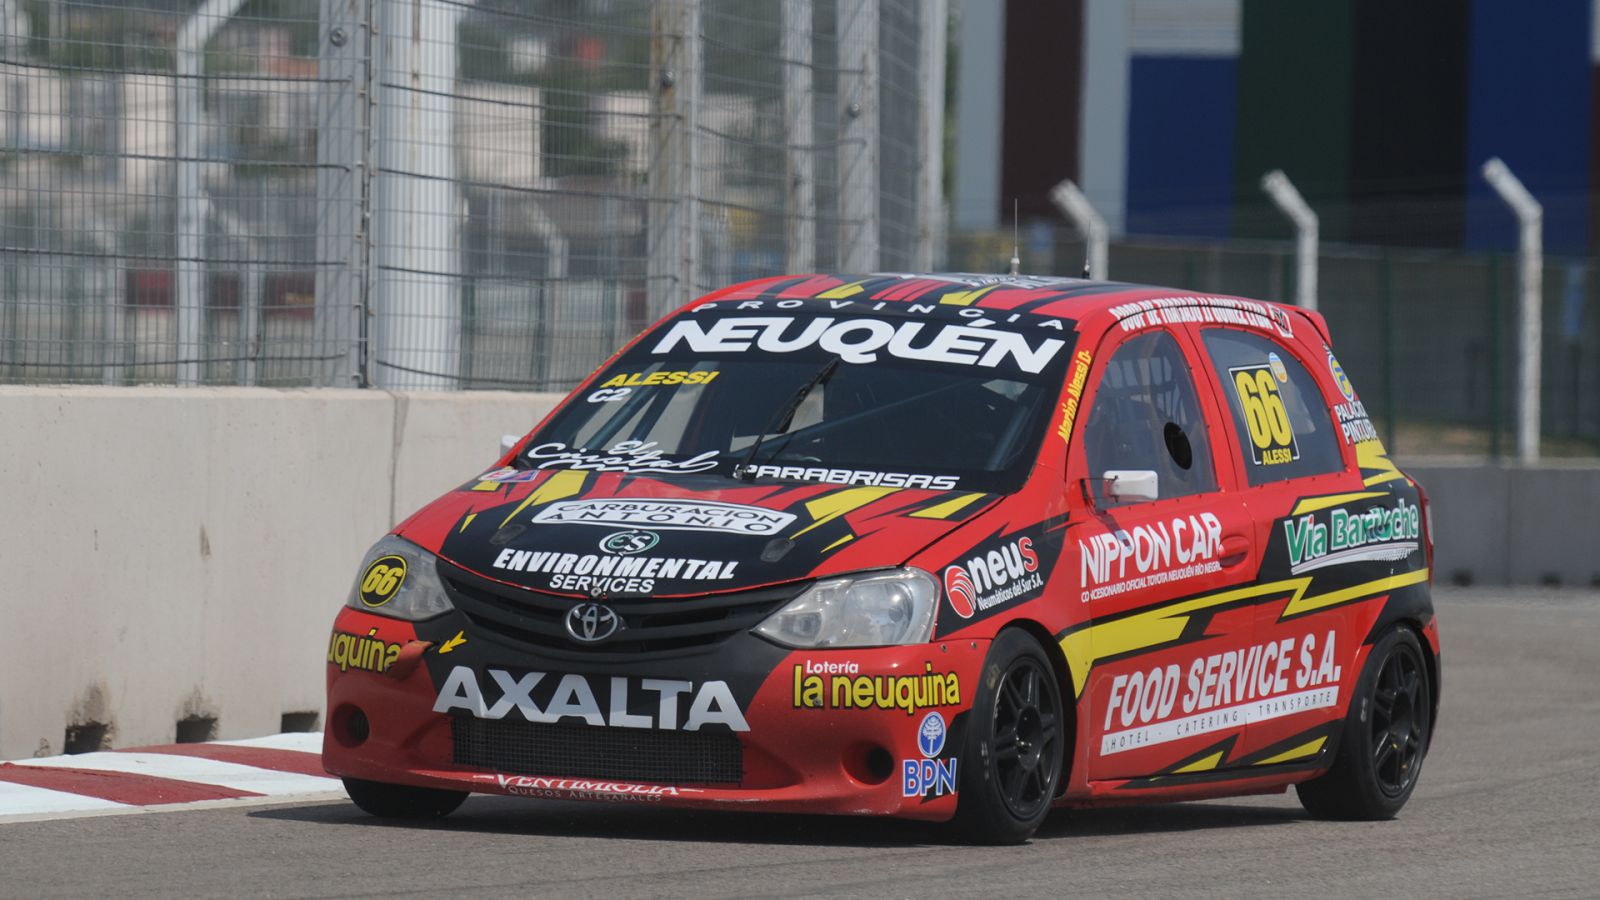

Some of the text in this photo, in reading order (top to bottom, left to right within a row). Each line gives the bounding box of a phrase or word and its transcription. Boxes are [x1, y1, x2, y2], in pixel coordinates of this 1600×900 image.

[692, 299, 1064, 331] PROVINCIA
[651, 316, 1066, 374] NEUQUÉN
[587, 387, 632, 403] C2
[600, 371, 720, 388] ALESSI
[1067, 359, 1088, 402] Alessi
[1235, 369, 1293, 449] 66
[1262, 447, 1293, 465] ALESSI
[542, 511, 773, 532] ANTONIO
[557, 503, 784, 523] CARBURACION
[1078, 512, 1222, 588] NIPPON CAR
[1284, 514, 1328, 566] Via
[362, 564, 404, 596] 66
[493, 548, 739, 580] ENVIRONMENTAL
[549, 574, 655, 593] SERVICES
[1012, 580, 1023, 597] del
[1021, 579, 1032, 593] Sur
[1031, 573, 1044, 589] S.A.
[1126, 578, 1147, 591] OFICIAL
[1147, 572, 1168, 586] TOYOTA
[806, 660, 859, 674] Lotería
[1104, 630, 1342, 731] FOOD SERVICE S.A.
[432, 665, 751, 732] AXALTA
[793, 665, 825, 709] la
[831, 662, 961, 715] neuquina
[1110, 731, 1150, 749] HOTEL
[1176, 710, 1238, 736] CATERING
[1258, 690, 1332, 716] TRANSPORTE
[508, 786, 662, 801] QUESOS ARTESANALES
[903, 758, 957, 797] BPN
